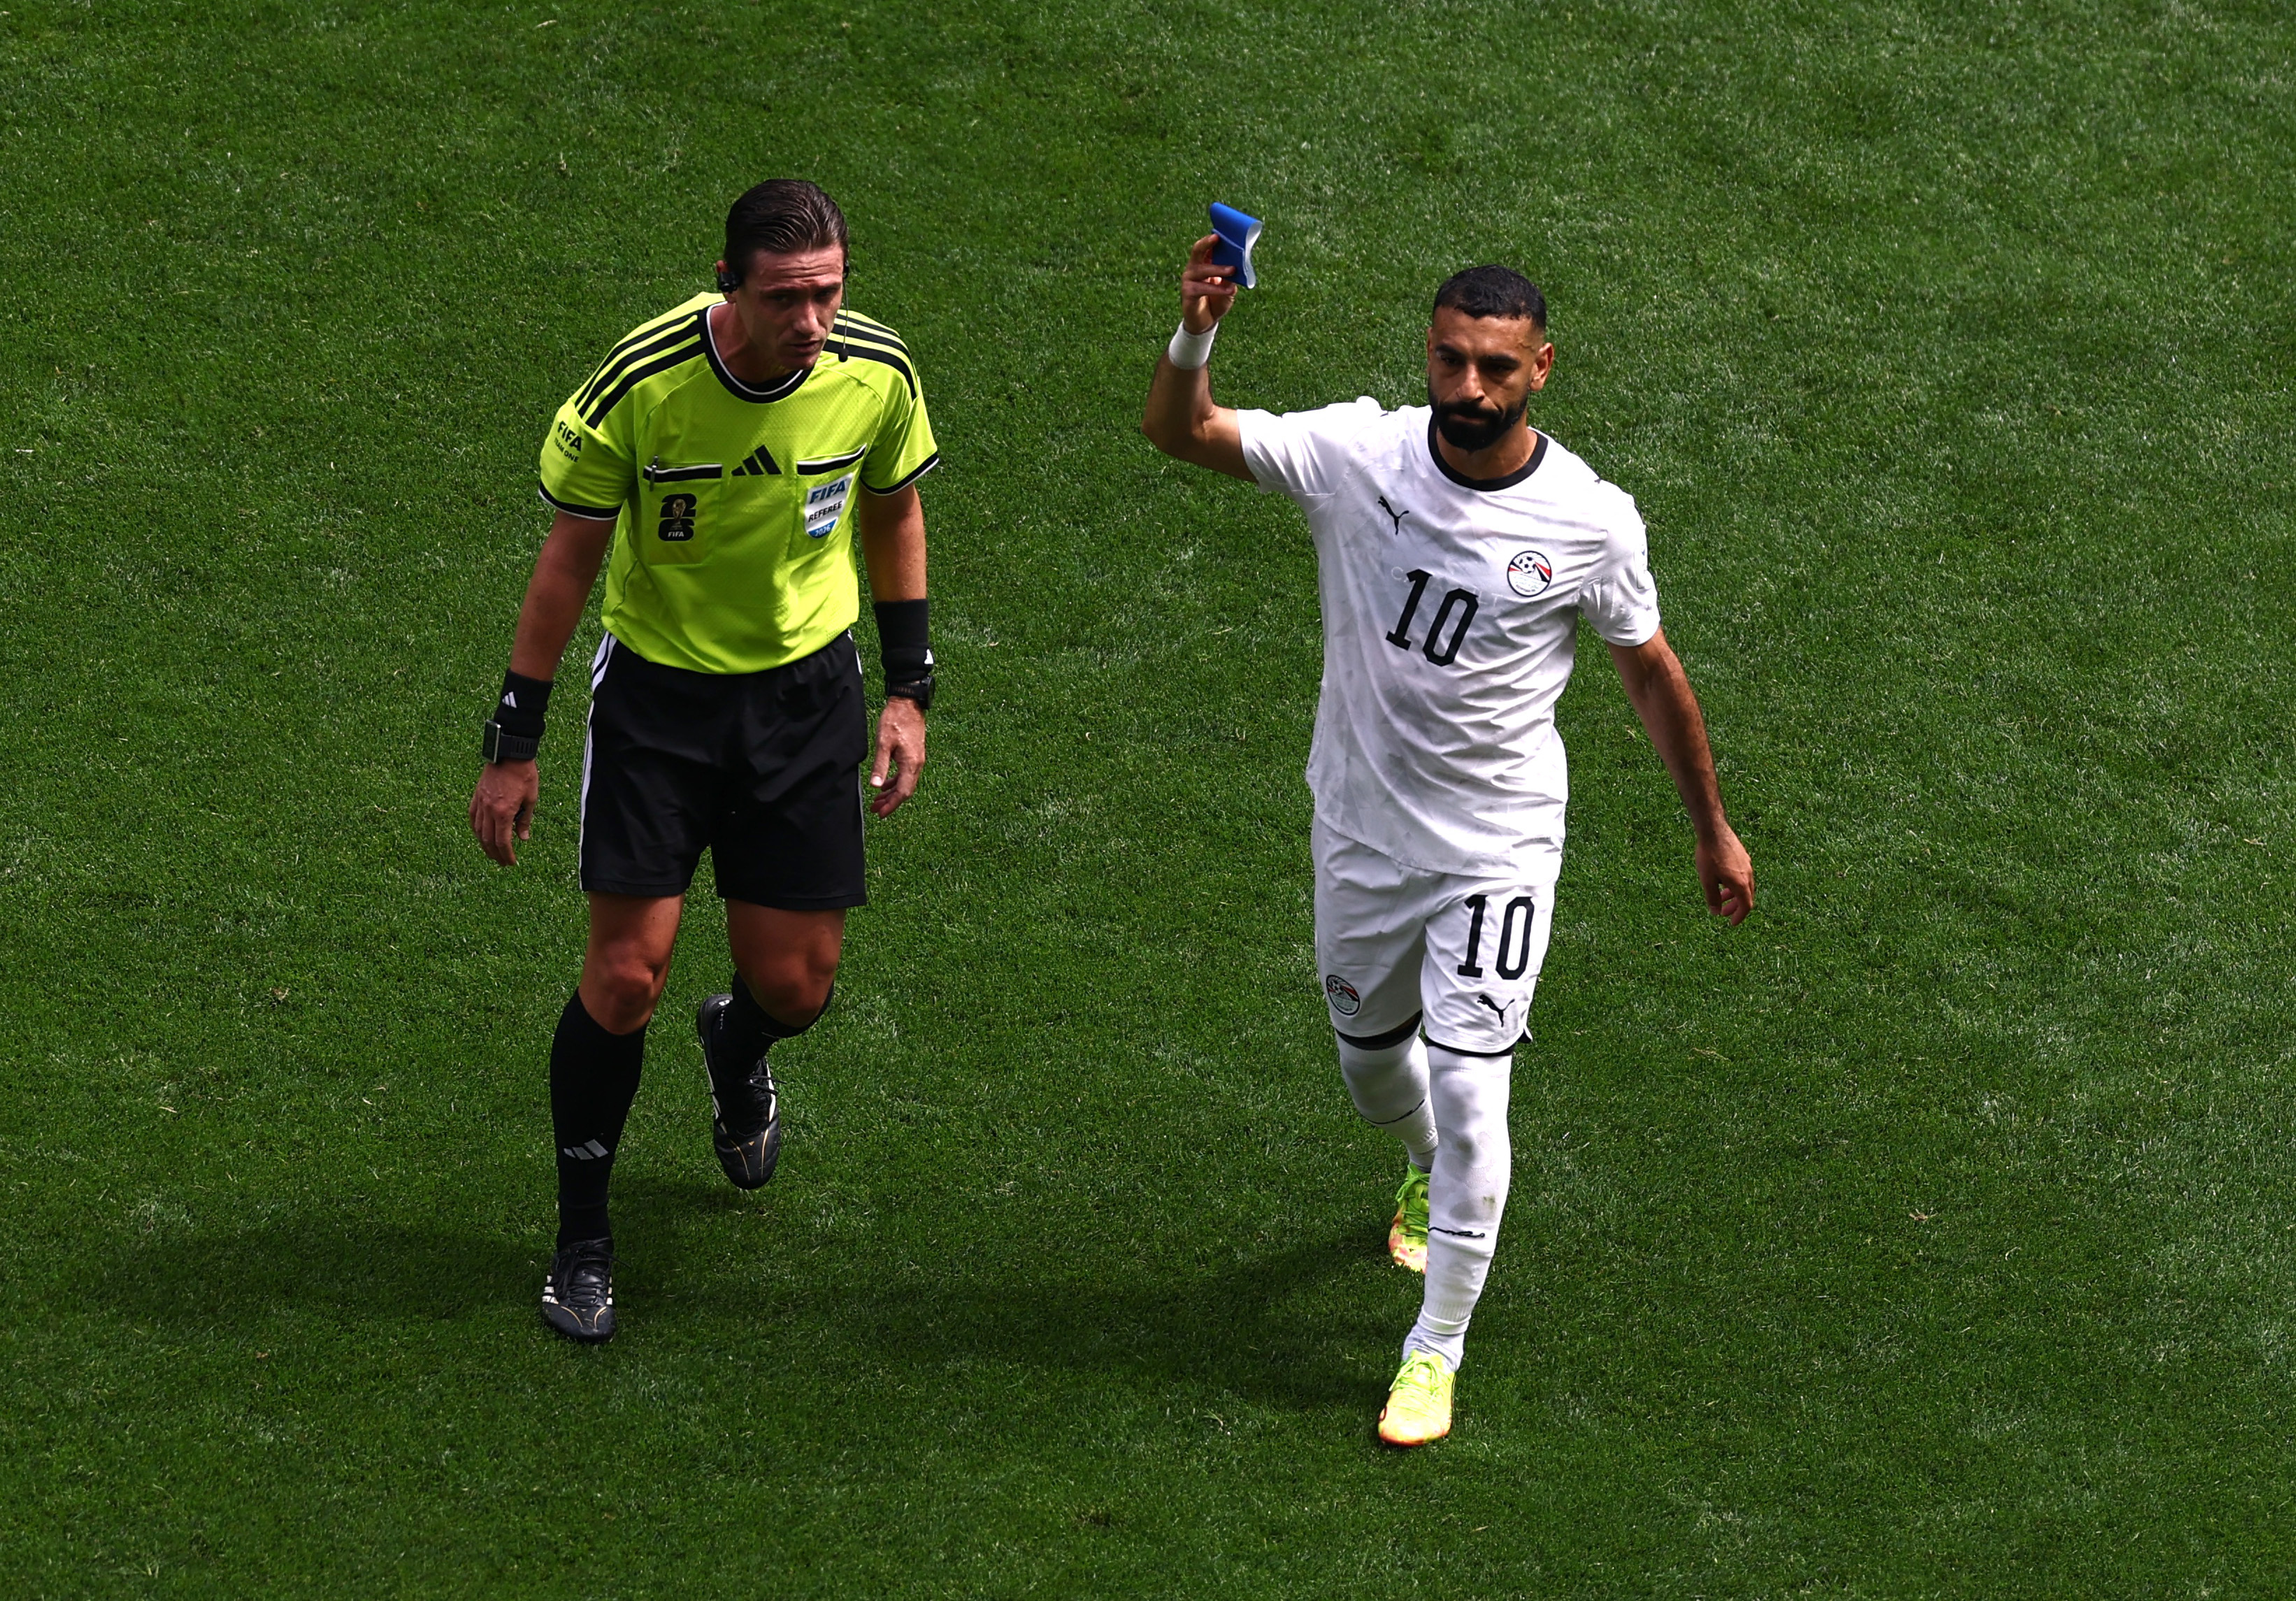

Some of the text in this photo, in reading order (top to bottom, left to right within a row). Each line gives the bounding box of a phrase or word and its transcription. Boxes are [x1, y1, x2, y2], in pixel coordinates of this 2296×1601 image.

[557, 420, 582, 452] FIFA
[564, 450, 580, 463] ONE
[810, 480, 846, 504] FIFA
[808, 500, 842, 522] REFEREE
[815, 524, 831, 537] 2026
[1385, 568, 1479, 667] 10
[1457, 894, 1535, 980] 10
